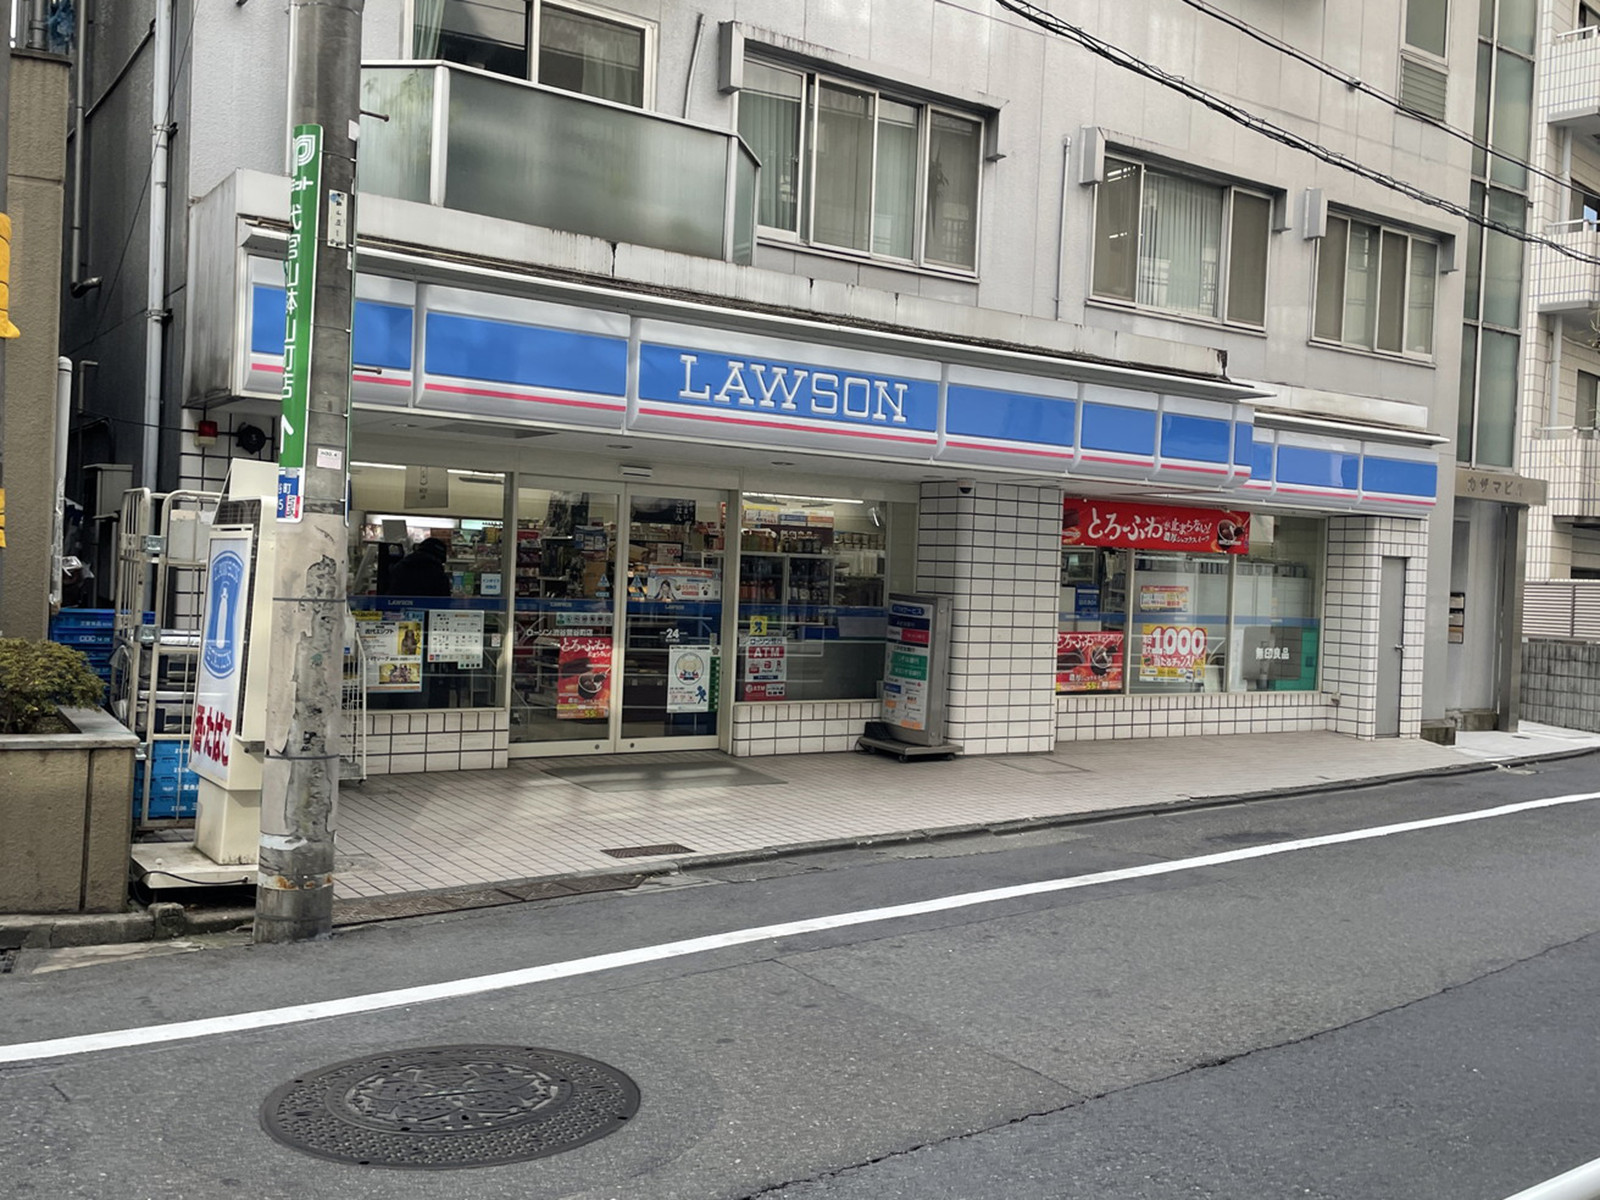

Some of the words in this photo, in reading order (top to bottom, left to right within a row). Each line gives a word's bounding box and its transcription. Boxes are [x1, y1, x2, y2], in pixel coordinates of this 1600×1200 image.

[679, 354, 908, 423] LAWSON
[665, 628, 679, 638] 24
[753, 647, 780, 658] ATM
[1256, 646, 1290, 660] 無印良品
